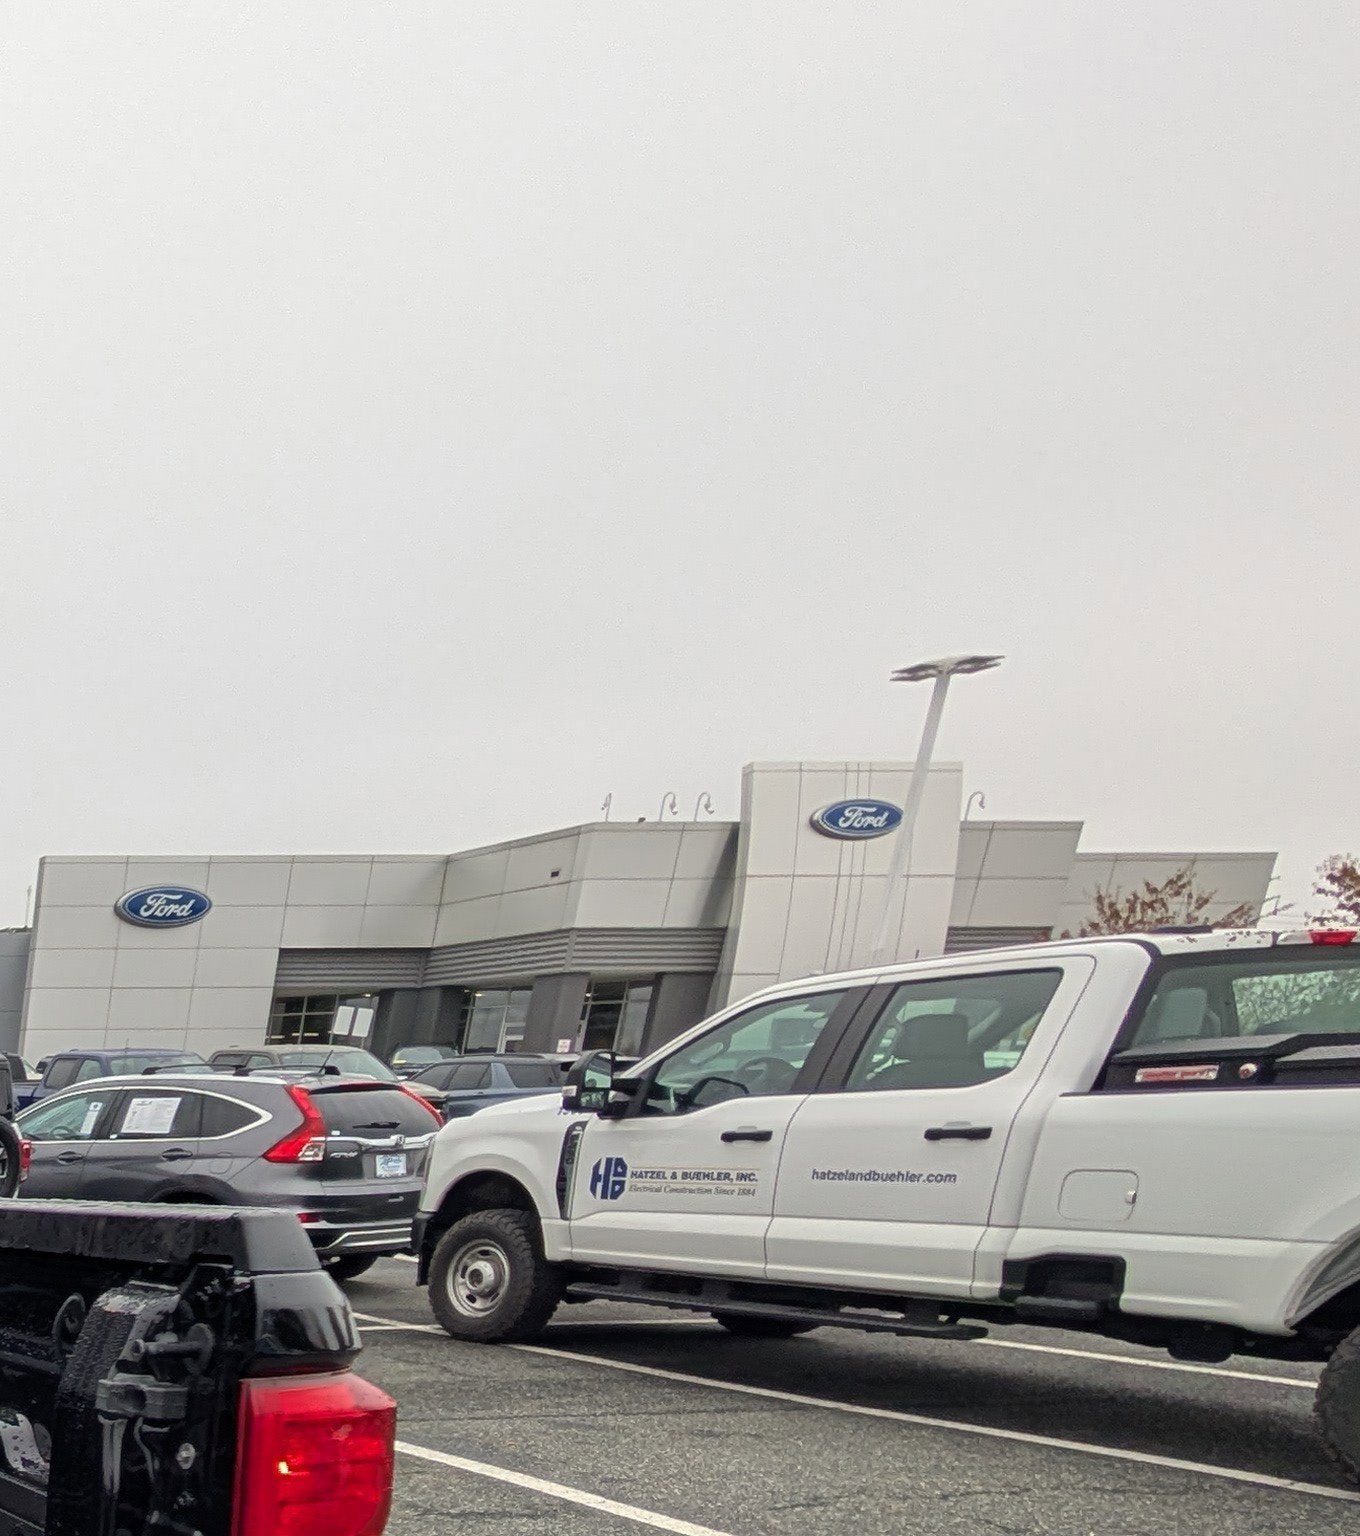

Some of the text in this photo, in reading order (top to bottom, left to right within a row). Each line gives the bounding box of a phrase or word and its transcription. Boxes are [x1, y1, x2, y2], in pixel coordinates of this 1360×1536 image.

[839, 806, 889, 828] Ford
[140, 893, 196, 917] Ford
[630, 1170, 758, 1182] HATZEL & BUEHLER, INC.
[811, 1169, 957, 1183] hatzelandbuehler.com
